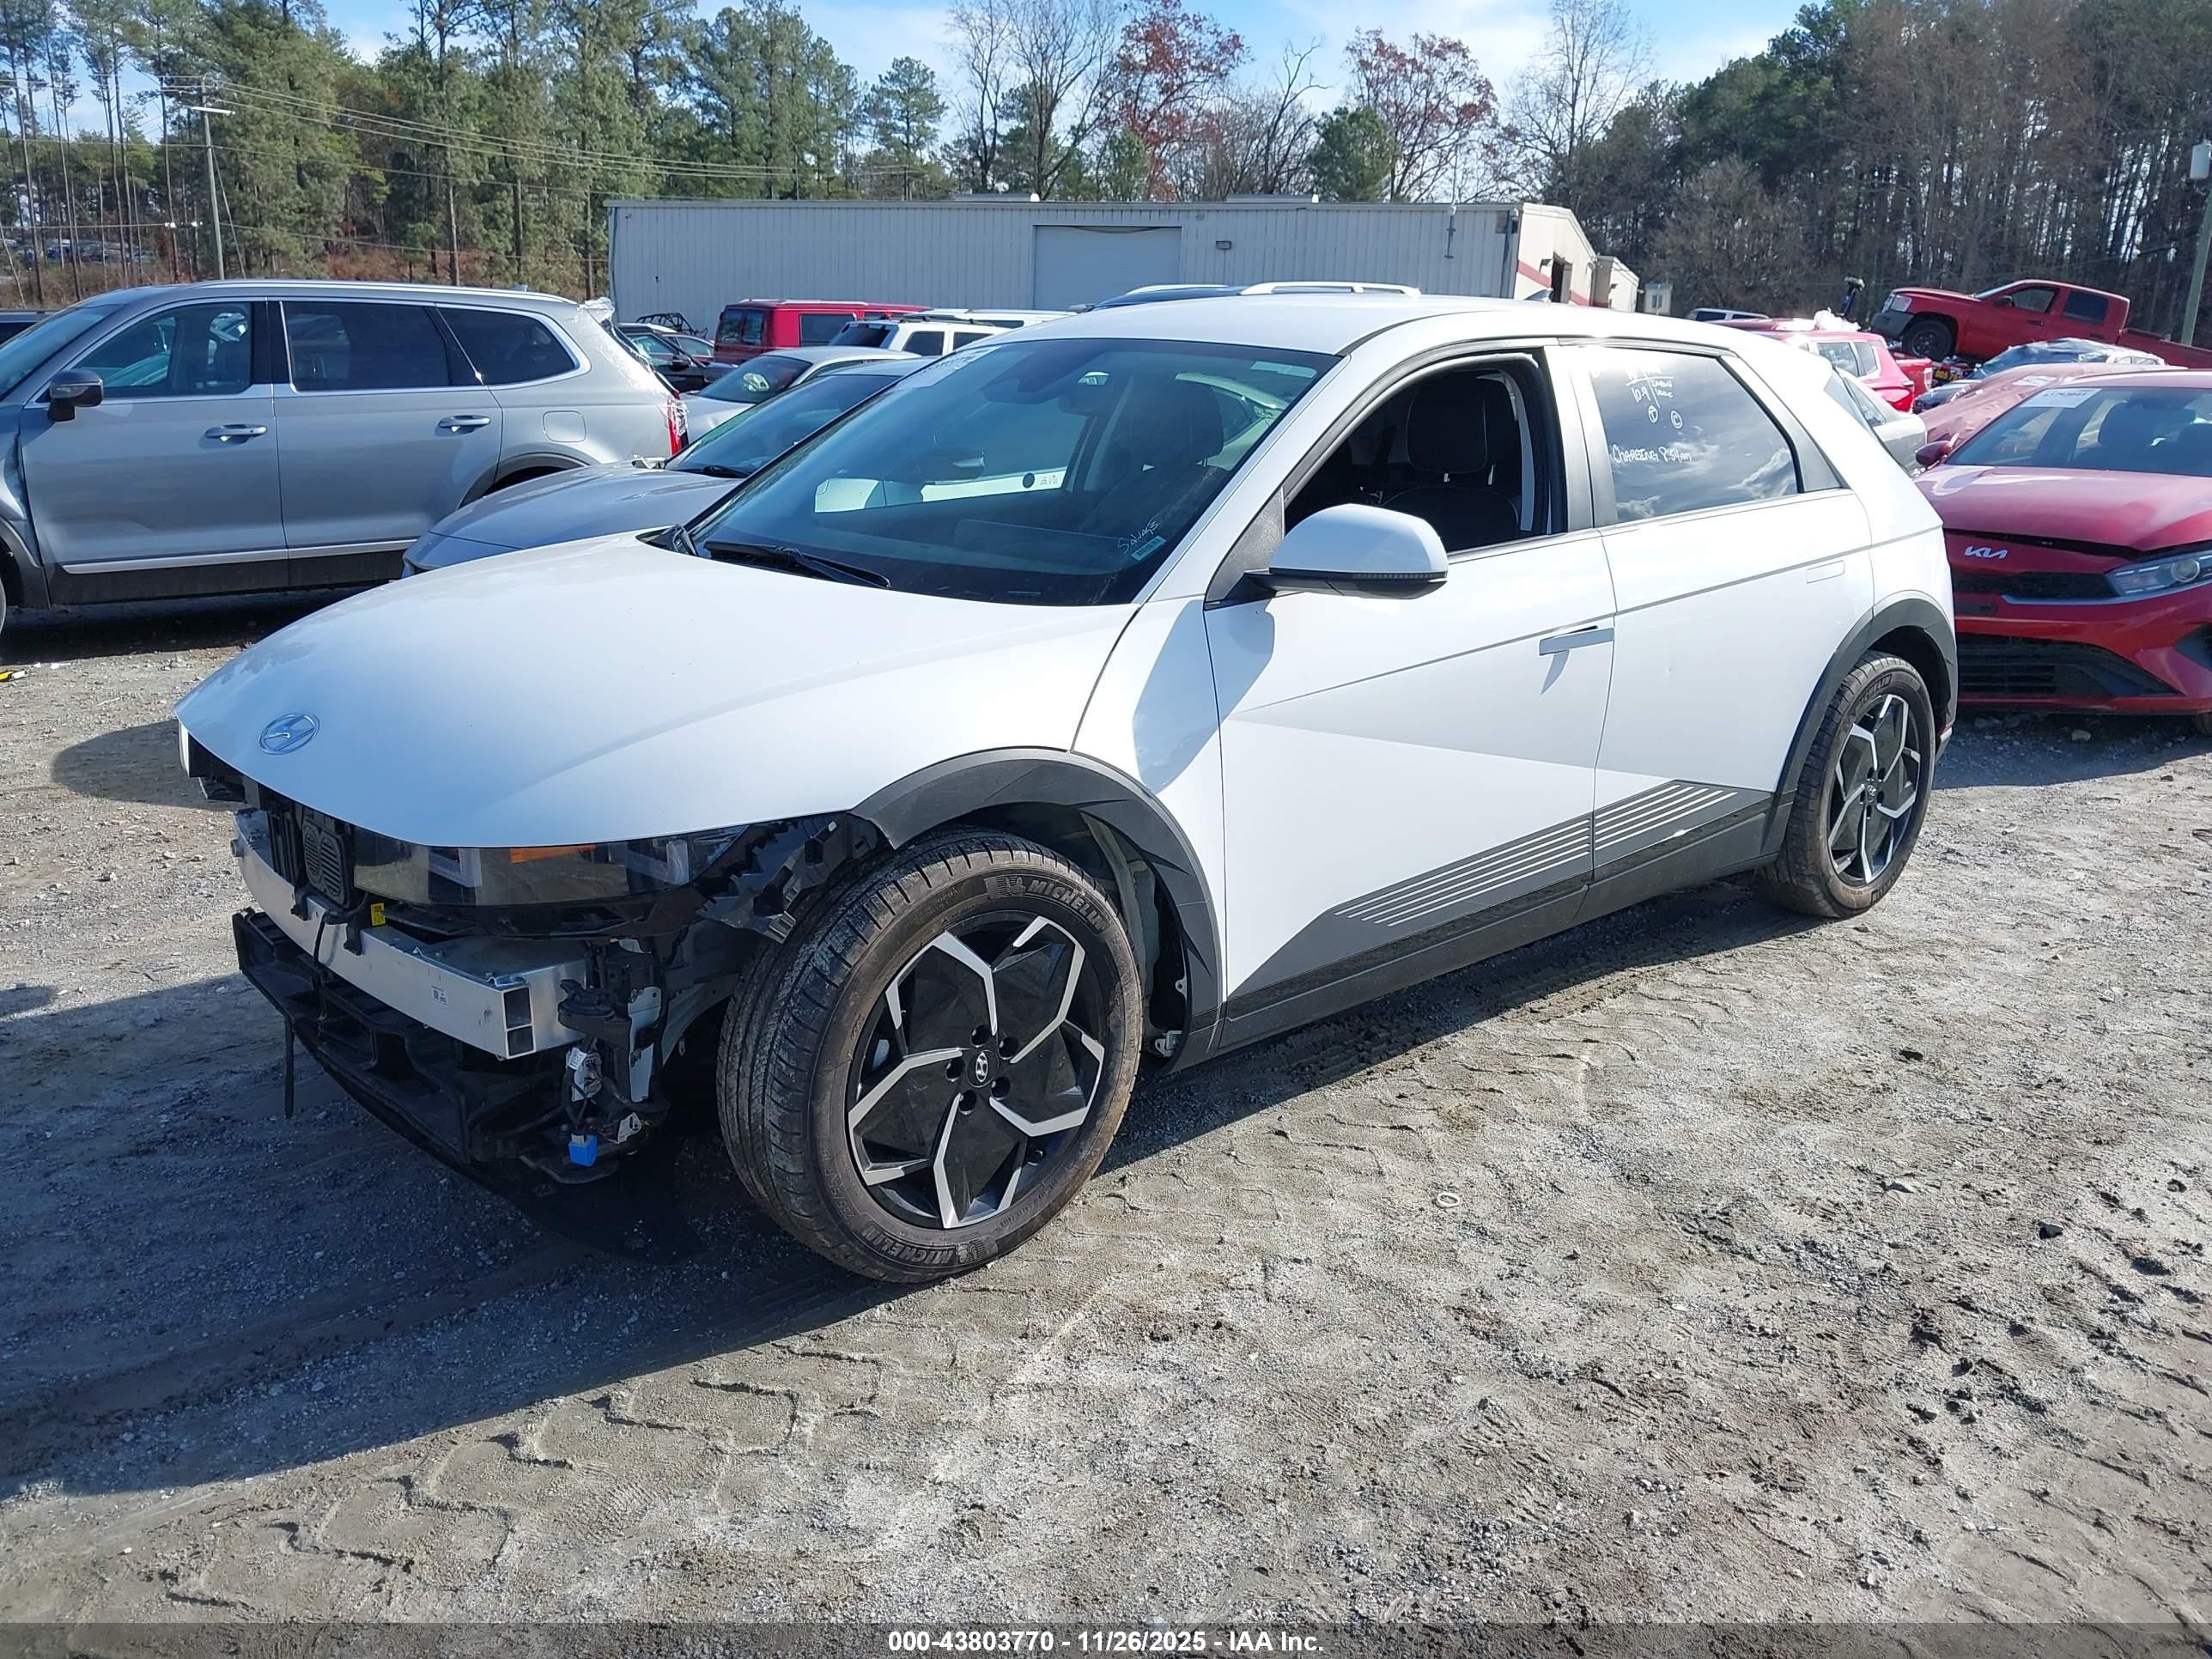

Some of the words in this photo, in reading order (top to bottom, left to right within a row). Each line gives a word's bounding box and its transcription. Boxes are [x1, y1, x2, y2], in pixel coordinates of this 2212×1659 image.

[1965, 545, 2008, 559] KIA
[1028, 879, 1109, 931] MICHELIN
[861, 1228, 954, 1264] MICHELIN
